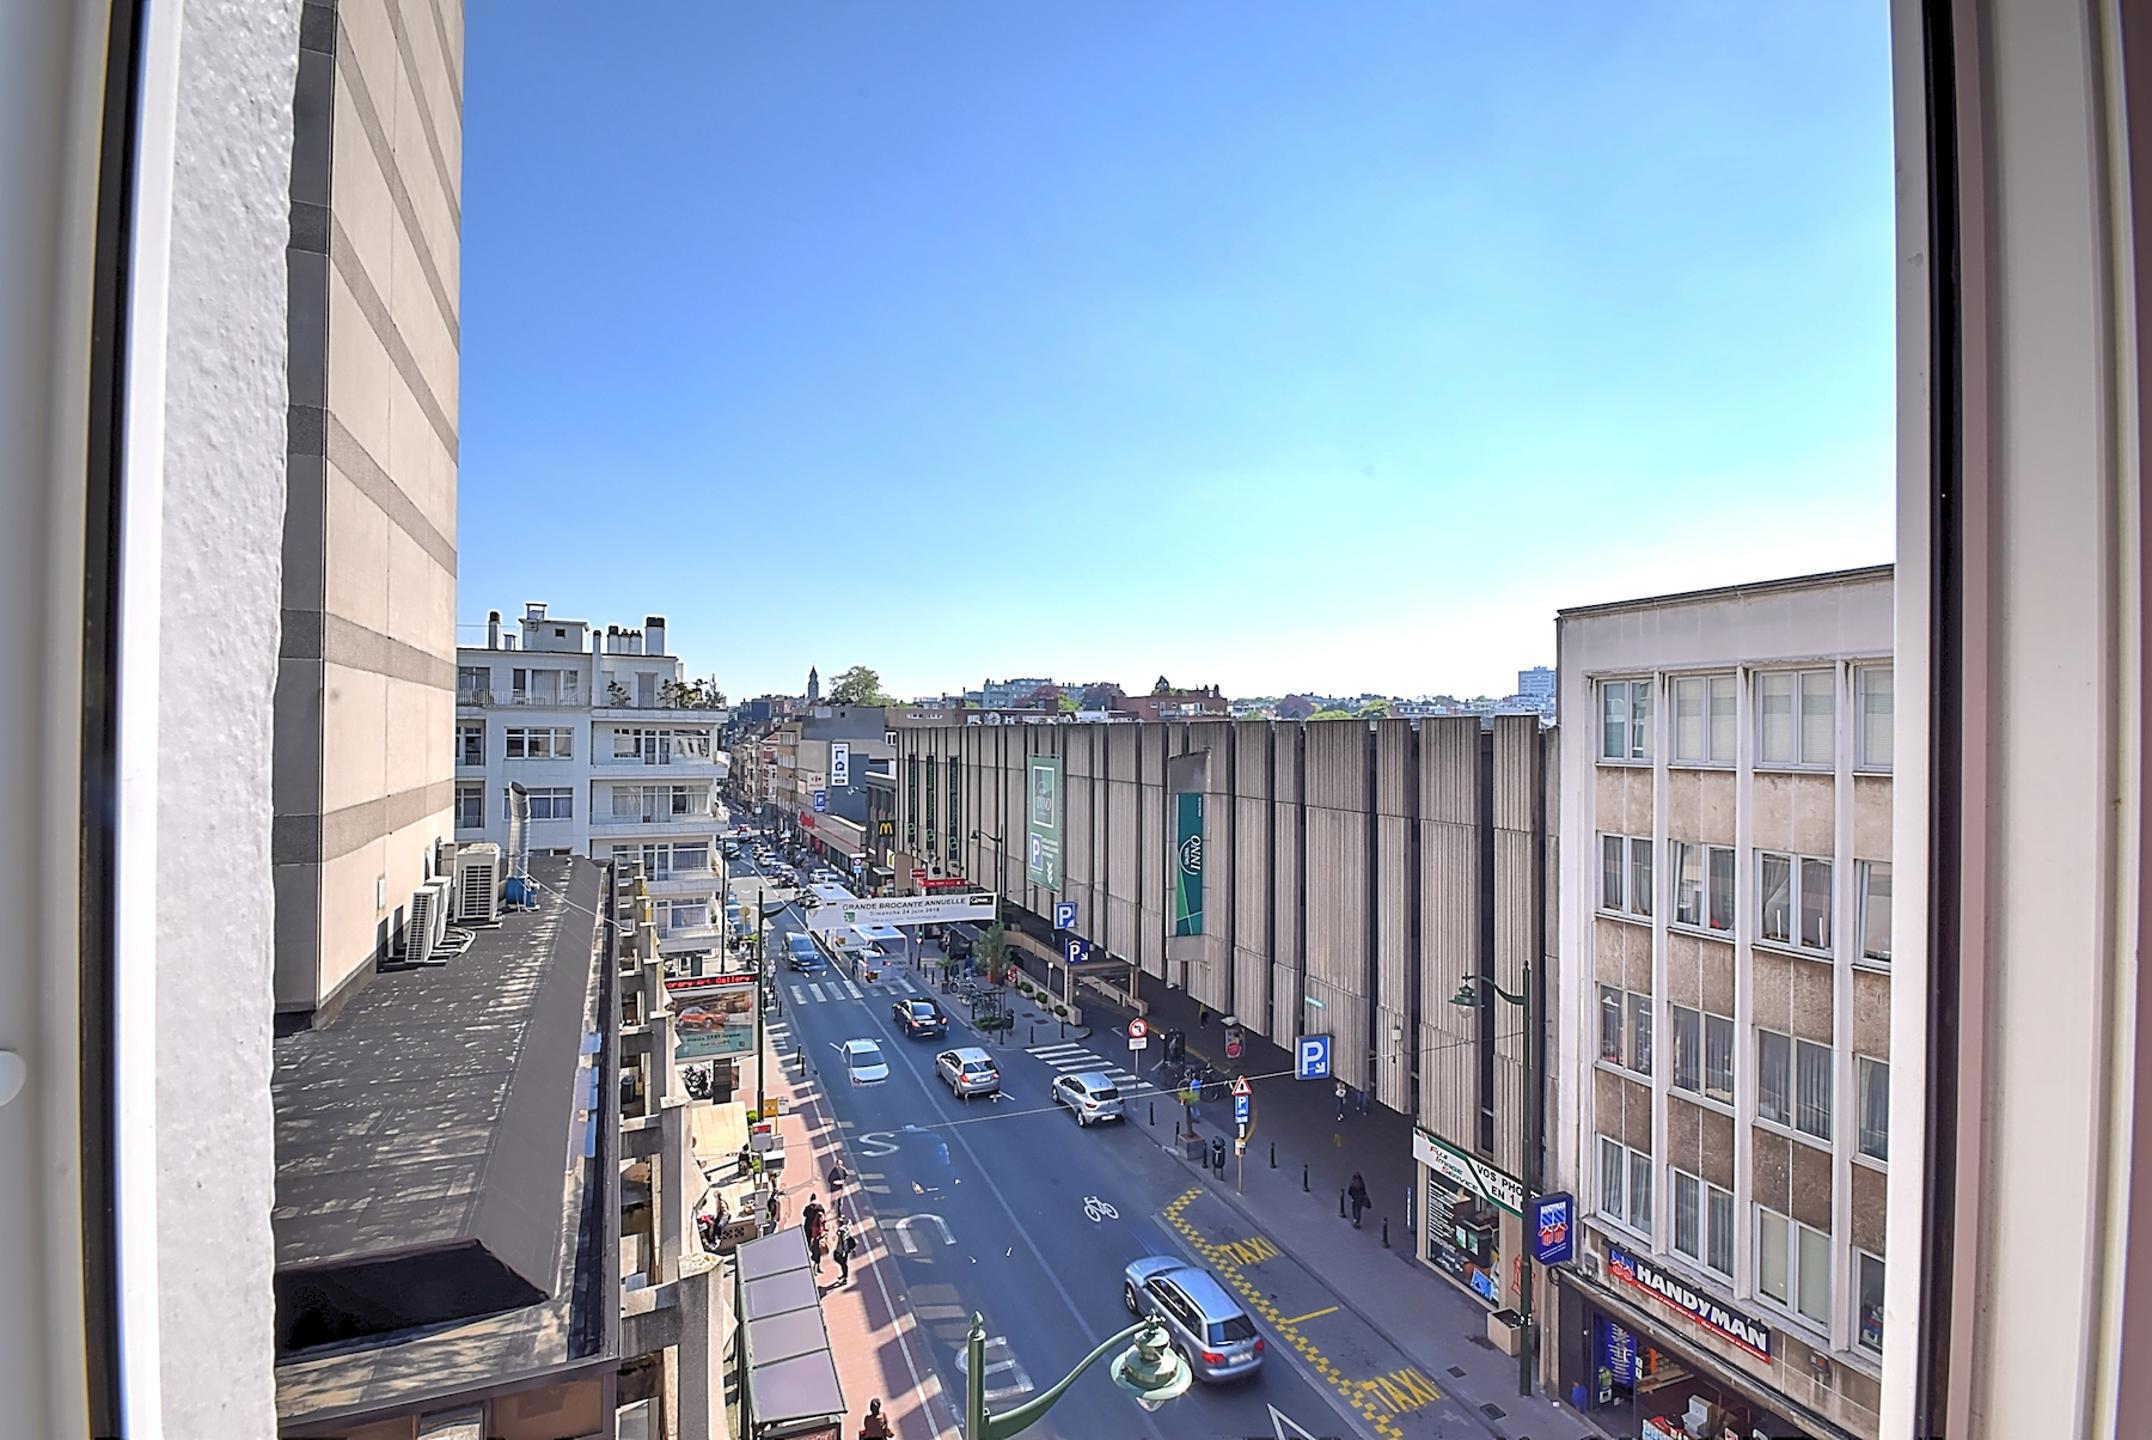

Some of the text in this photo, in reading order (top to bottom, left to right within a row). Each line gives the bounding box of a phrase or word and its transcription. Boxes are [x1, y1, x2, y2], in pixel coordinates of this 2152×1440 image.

[1032, 839, 1040, 864] P
[1190, 835, 1201, 871] INNO
[842, 898, 966, 911] GRANDE BROCANTE ANNUELLE
[1058, 906, 1072, 925] P
[1070, 944, 1080, 962] P
[1302, 1041, 1323, 1075] P
[1238, 1097, 1246, 1108] P
[1477, 1164, 1497, 1182] VOS
[1491, 1185, 1505, 1201] EN
[1216, 1235, 1280, 1265] TAXI
[1636, 1261, 1768, 1352] HANDYMAN
[1362, 1367, 1441, 1413] TAXI
